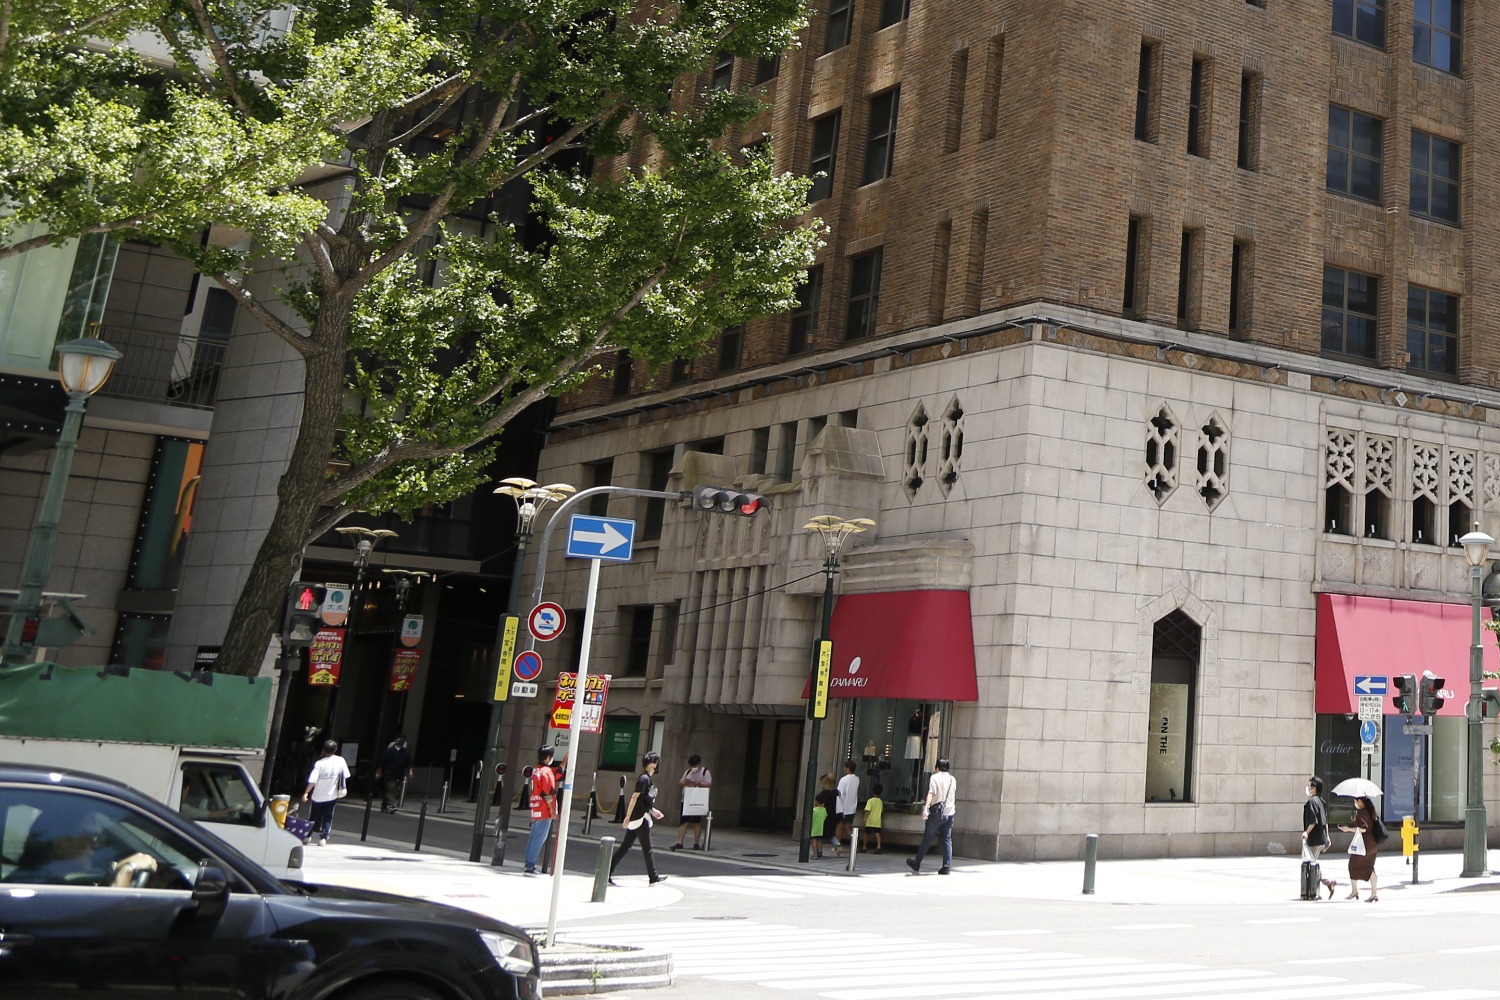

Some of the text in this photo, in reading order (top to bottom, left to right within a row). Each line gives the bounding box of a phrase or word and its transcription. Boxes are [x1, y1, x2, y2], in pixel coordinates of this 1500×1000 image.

[830, 677, 868, 687] DAIMARU
[513, 685, 537, 694] 自動車
[1320, 740, 1353, 754] Cartier
